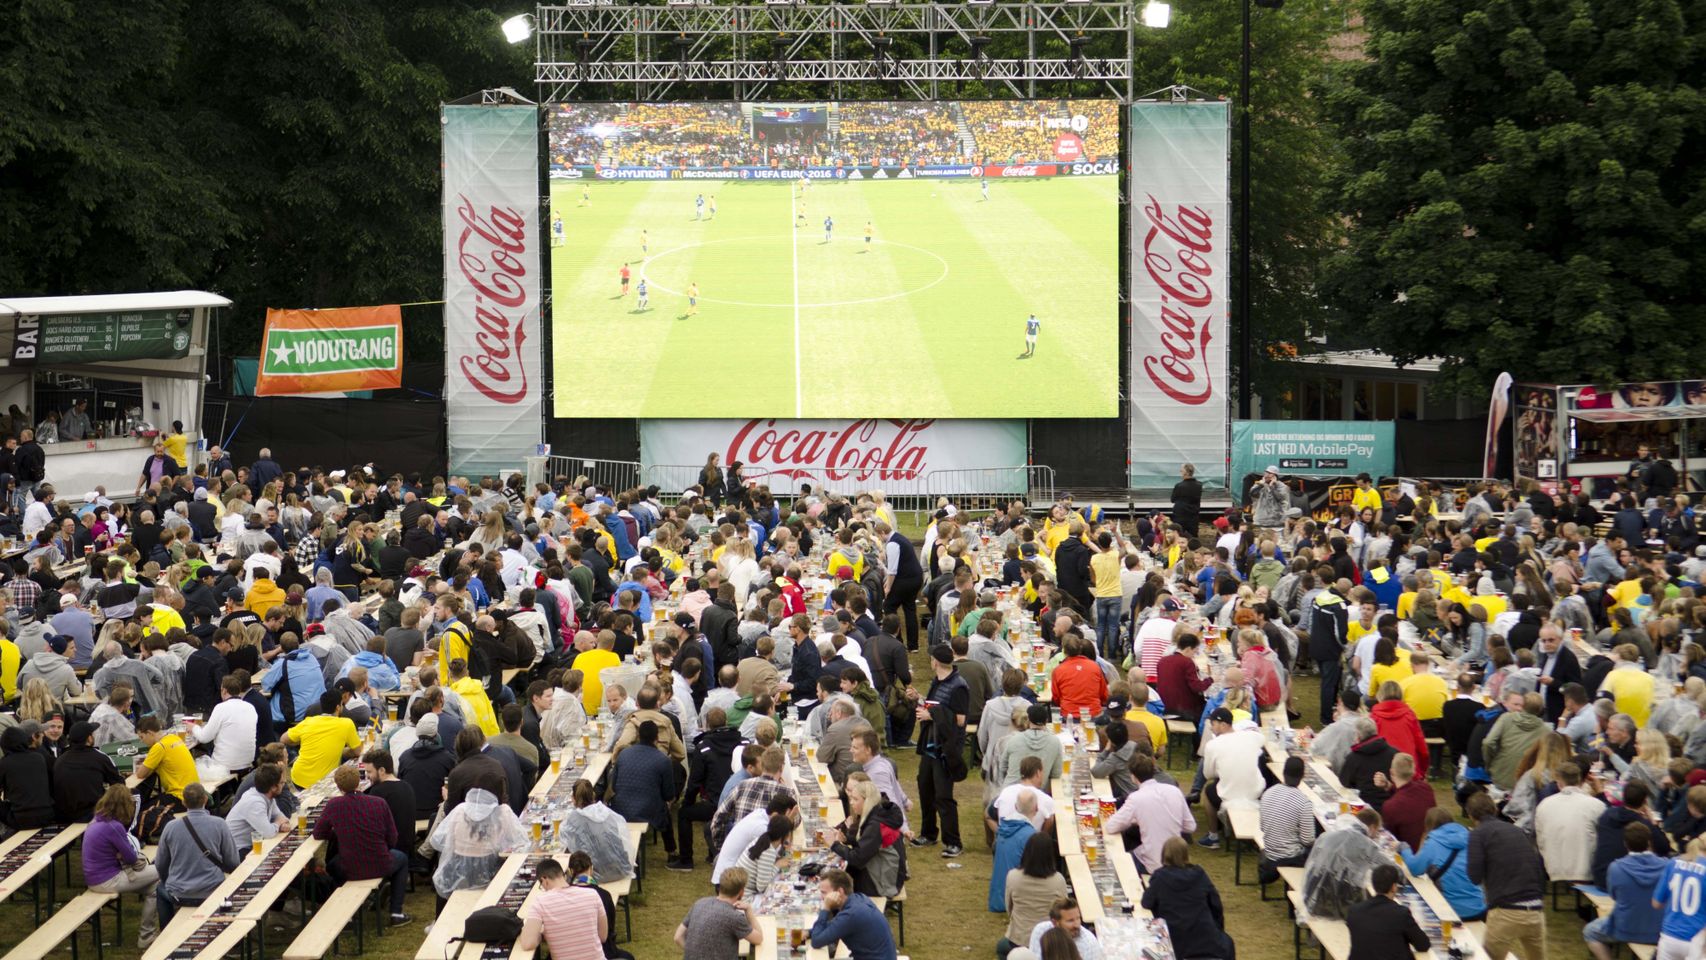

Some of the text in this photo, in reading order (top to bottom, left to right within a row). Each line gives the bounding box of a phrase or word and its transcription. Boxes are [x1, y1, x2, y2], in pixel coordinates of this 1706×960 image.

[618, 169, 667, 178] HYUNDAI
[682, 168, 739, 178] McDonald's
[754, 170, 780, 178] UEFA
[808, 169, 831, 178] 2016
[458, 192, 527, 404] Coca-Cola
[1144, 192, 1213, 405] Coca-Cola
[15, 315, 39, 359] BAR
[293, 336, 393, 367] NØDUTGANG
[725, 418, 936, 482] Coca-Cola
[1253, 442, 1374, 458] LAST NED MobilePay
[1668, 872, 1702, 916] 10
